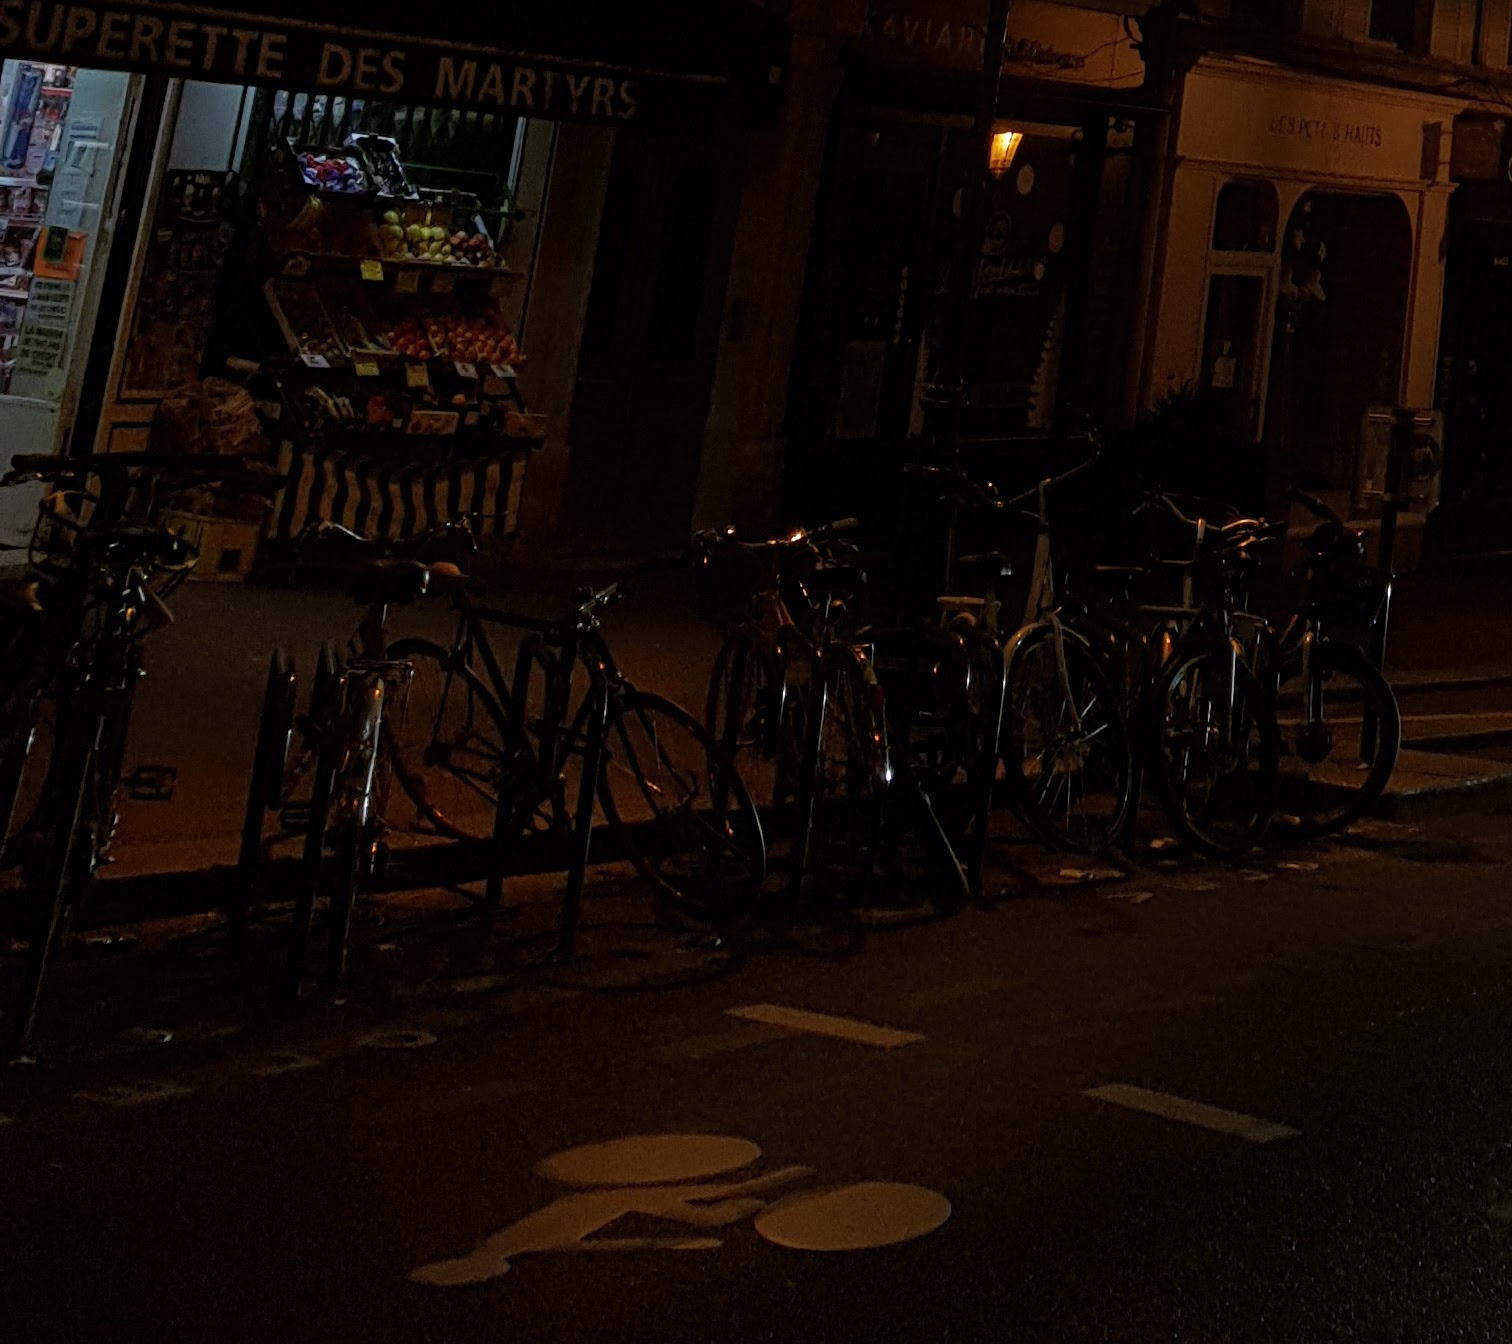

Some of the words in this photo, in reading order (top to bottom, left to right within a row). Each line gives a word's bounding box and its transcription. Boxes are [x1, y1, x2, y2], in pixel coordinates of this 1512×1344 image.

[314, 42, 407, 95] DES
[432, 56, 639, 120] MARTYRS
[1345, 123, 1382, 148] HAUTS
